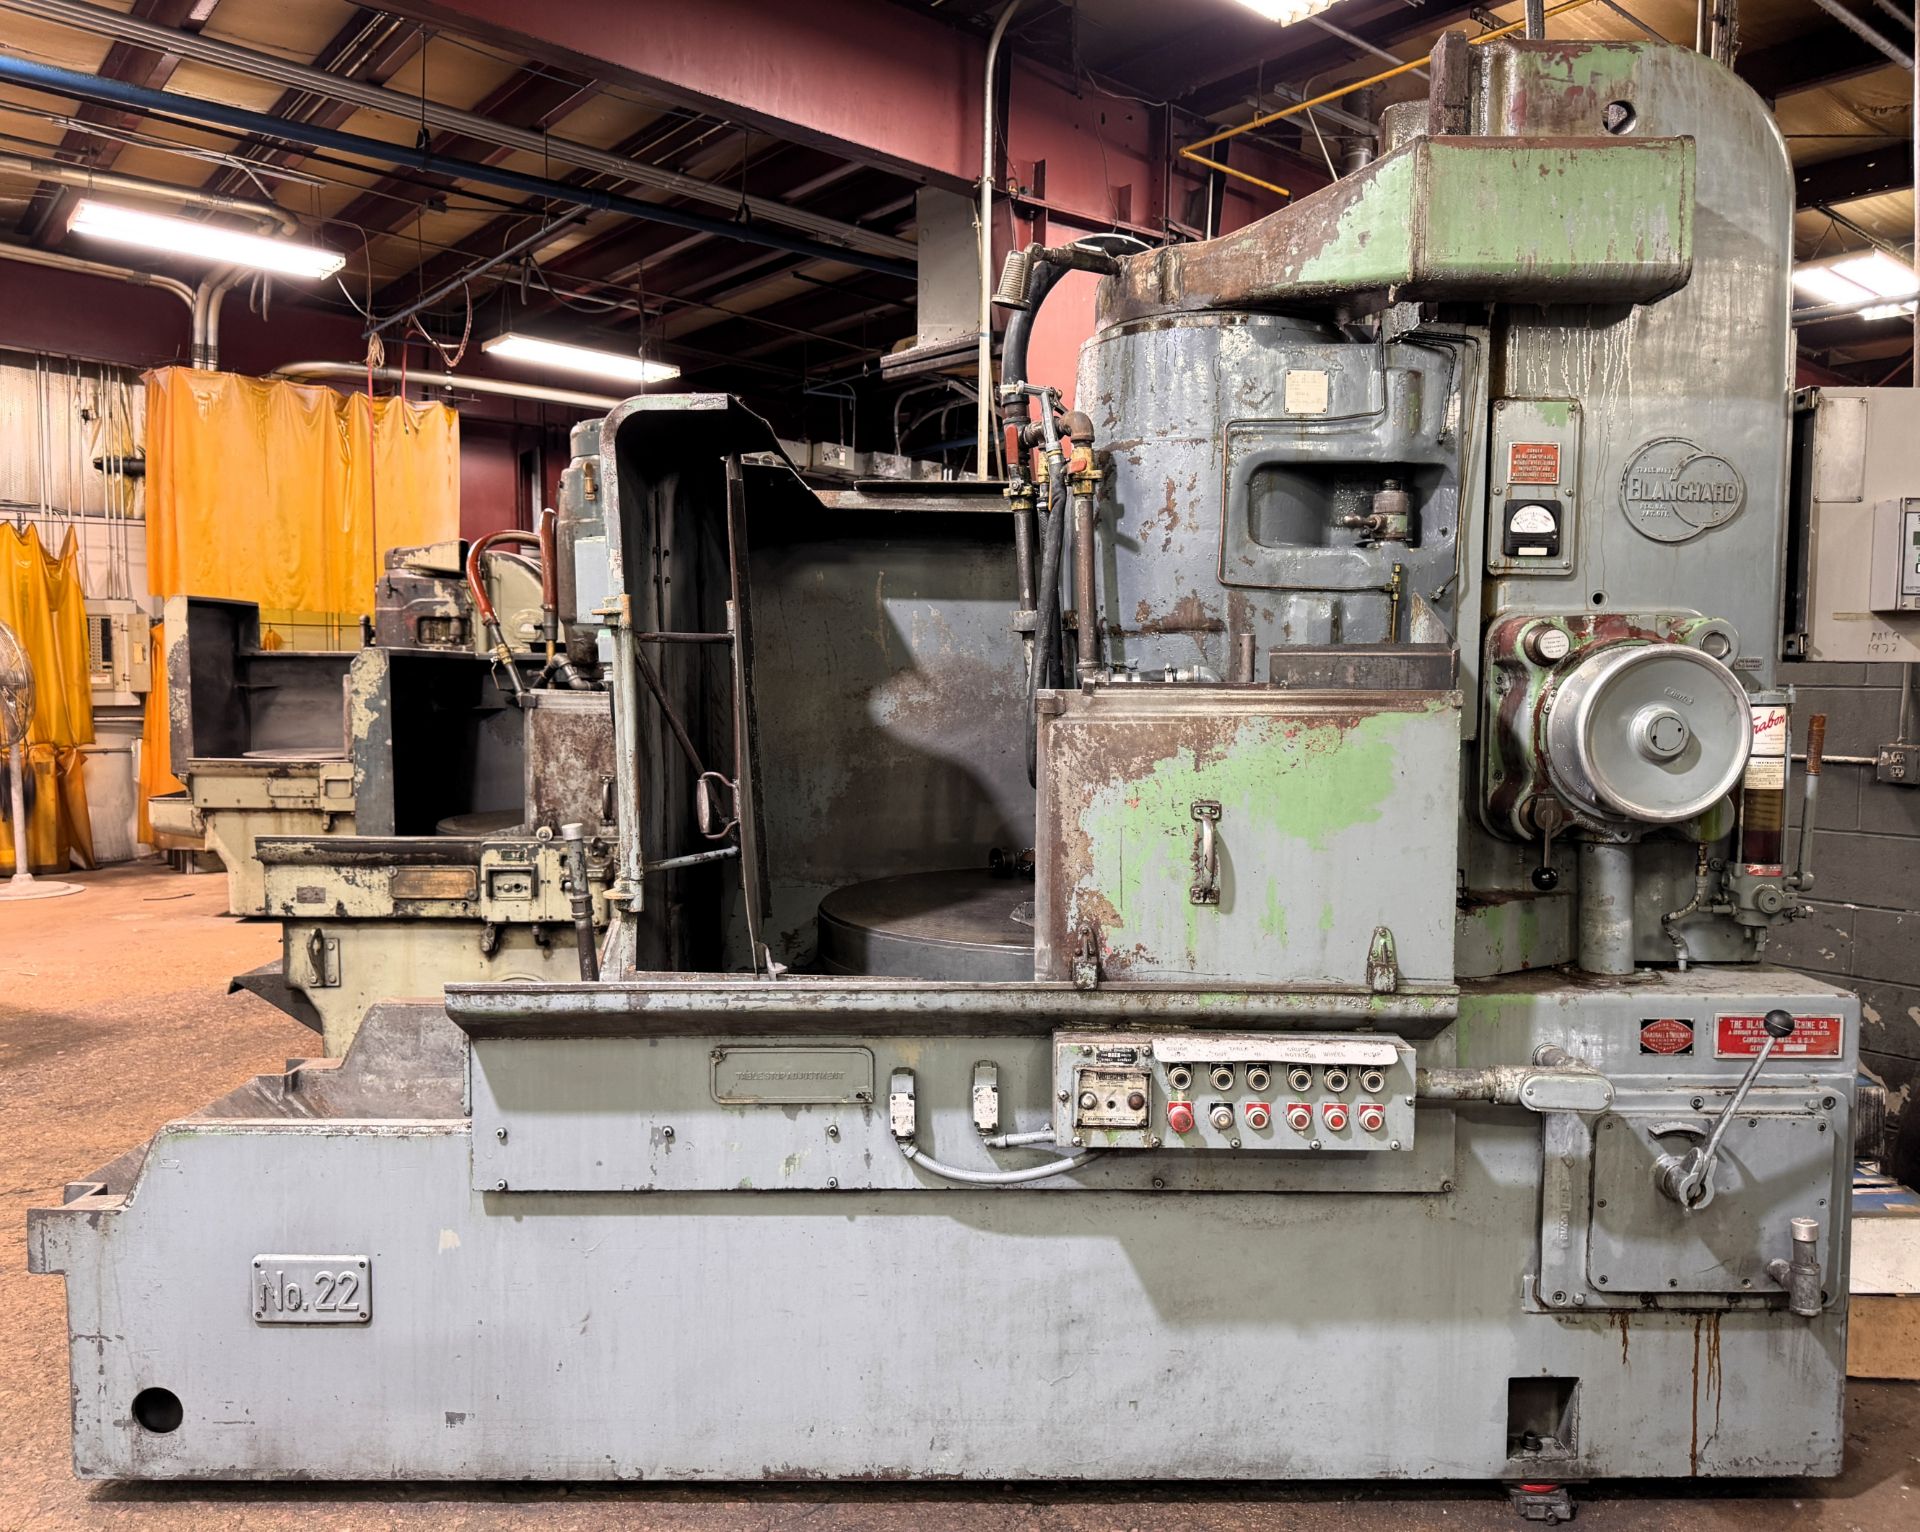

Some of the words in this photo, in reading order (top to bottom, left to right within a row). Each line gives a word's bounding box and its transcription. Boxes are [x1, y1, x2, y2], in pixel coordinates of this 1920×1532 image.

[1628, 478, 1738, 503] BLANCHARD
[1753, 710, 1785, 735] rabon
[735, 1071, 764, 1081] TABLE
[764, 1071, 786, 1081] STOP
[786, 1071, 846, 1081] ADJUSTMENT
[259, 1270, 309, 1312] No.
[314, 1270, 360, 1312] 22
